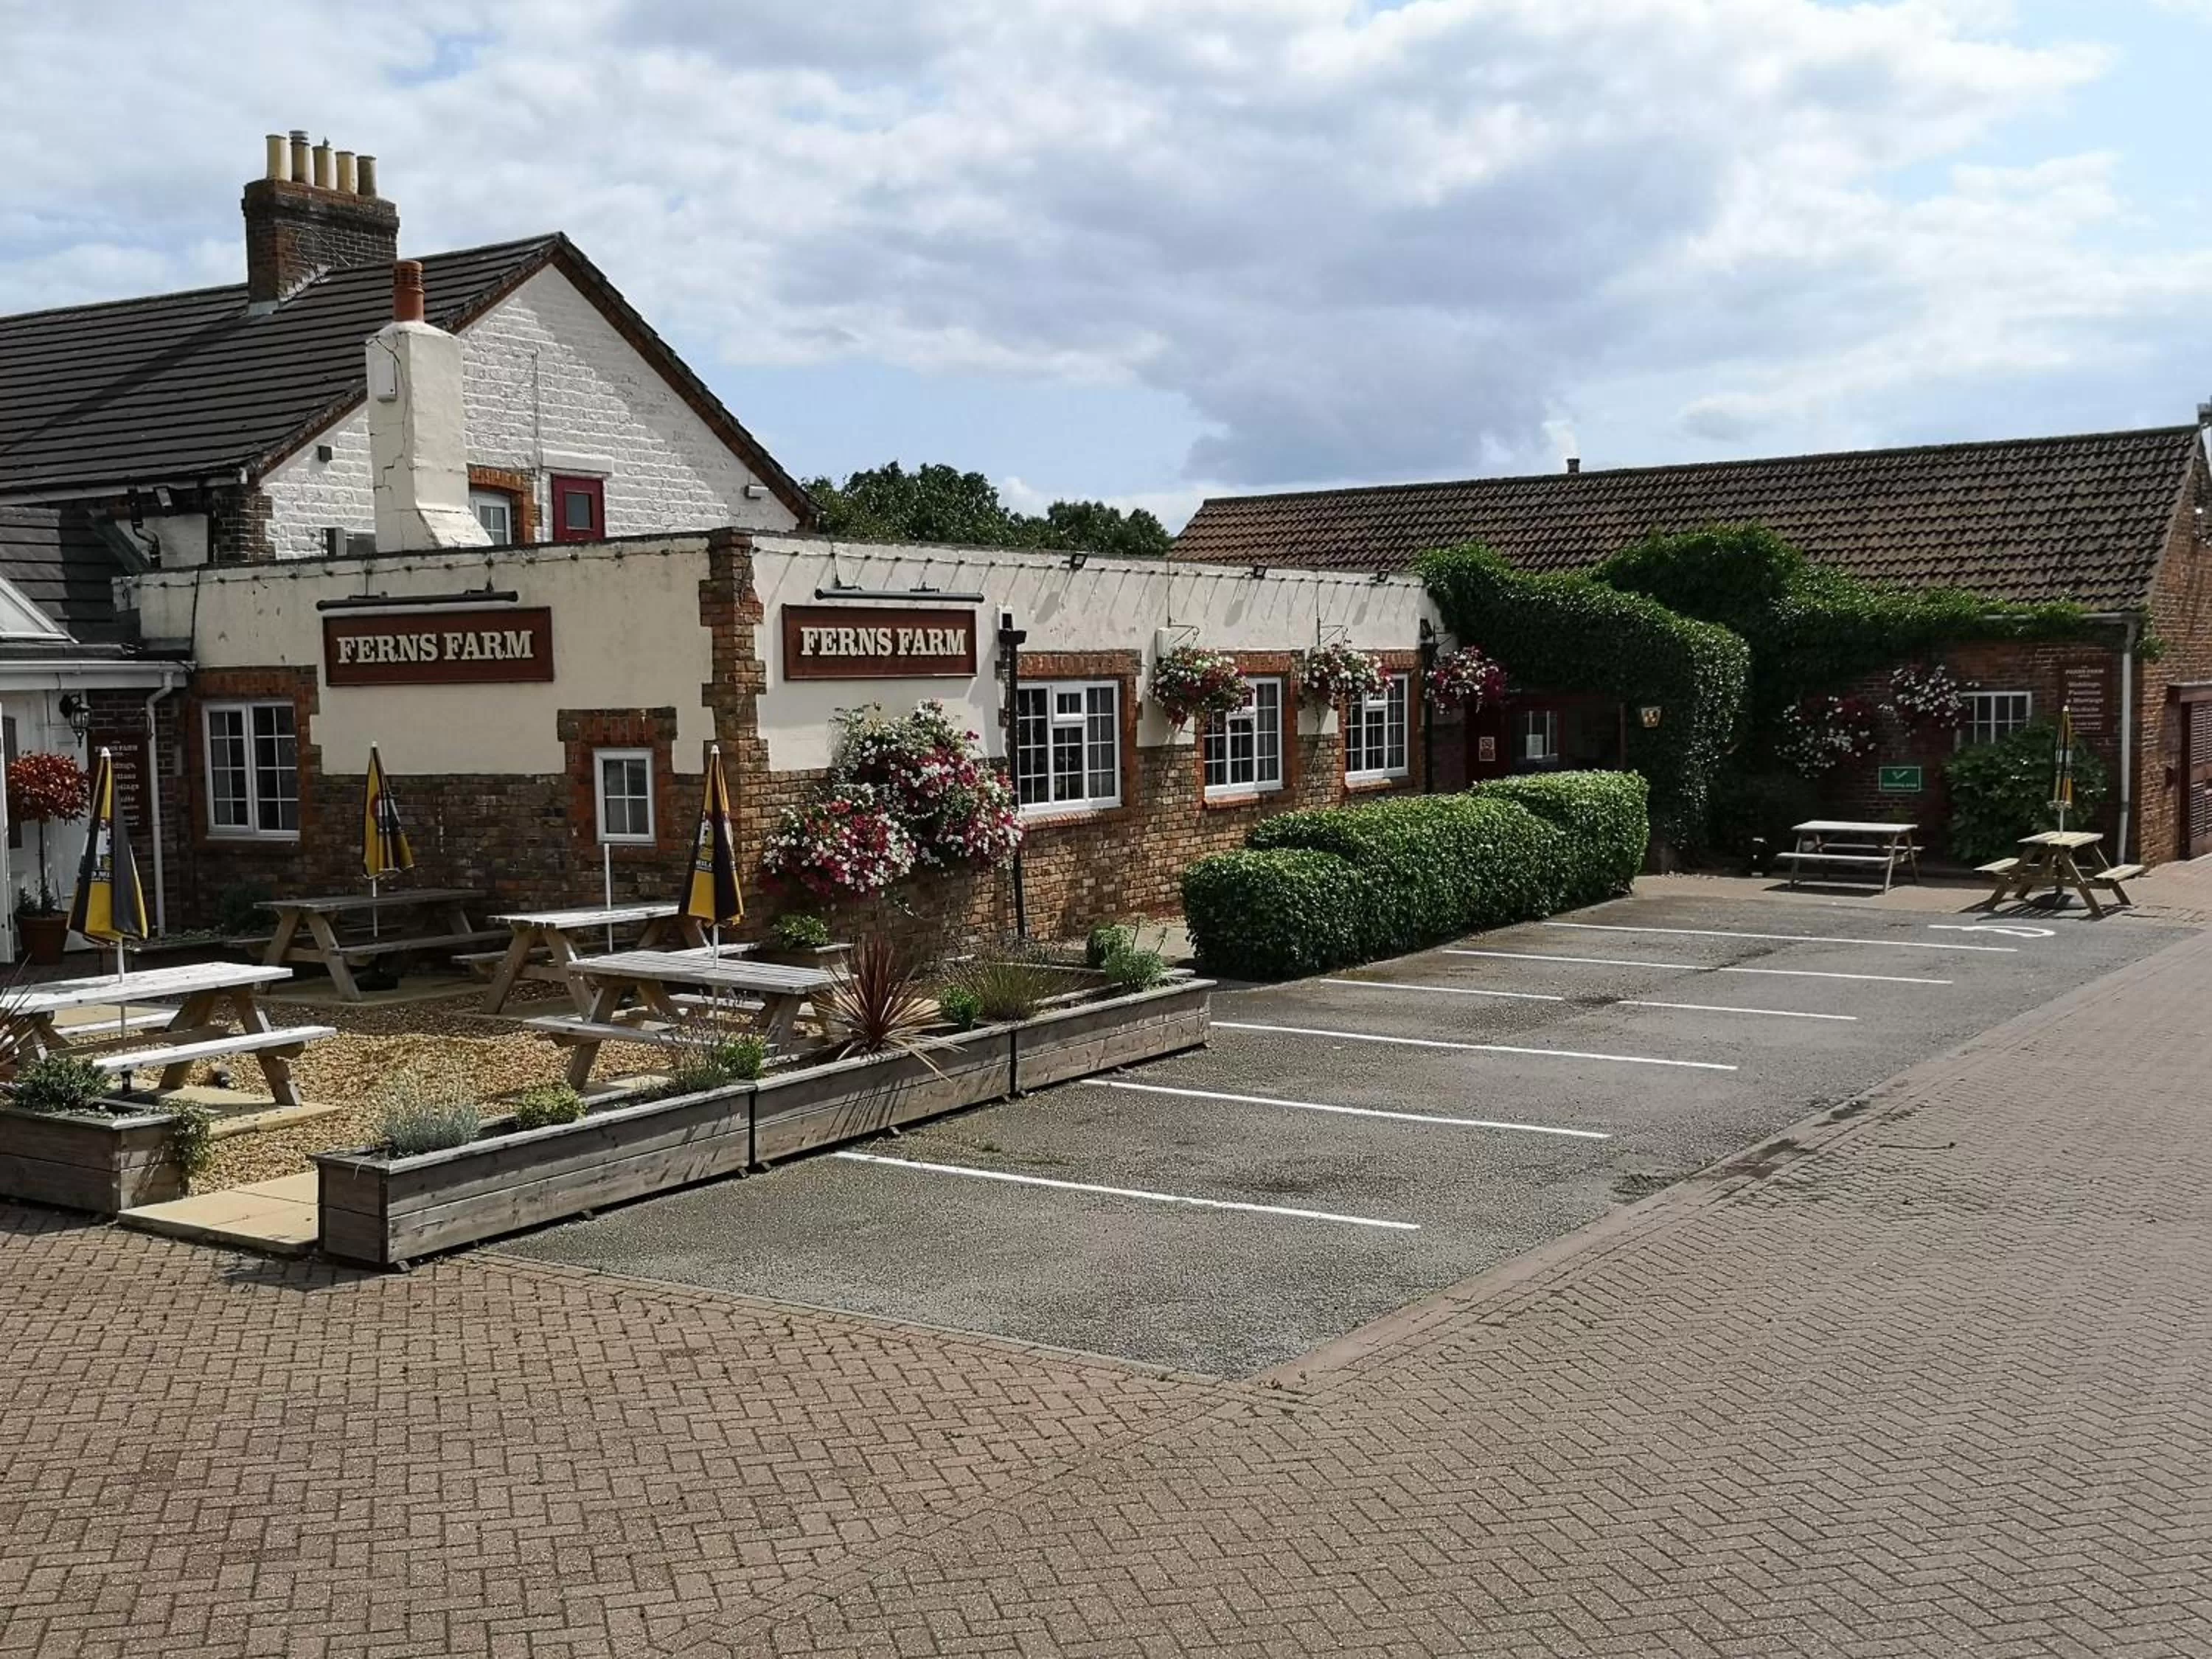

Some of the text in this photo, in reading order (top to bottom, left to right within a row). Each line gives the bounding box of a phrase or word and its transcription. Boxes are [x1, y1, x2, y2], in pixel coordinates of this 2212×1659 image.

[337, 630, 534, 664] FERNS FARM
[800, 625, 967, 656] FERNS FARM
